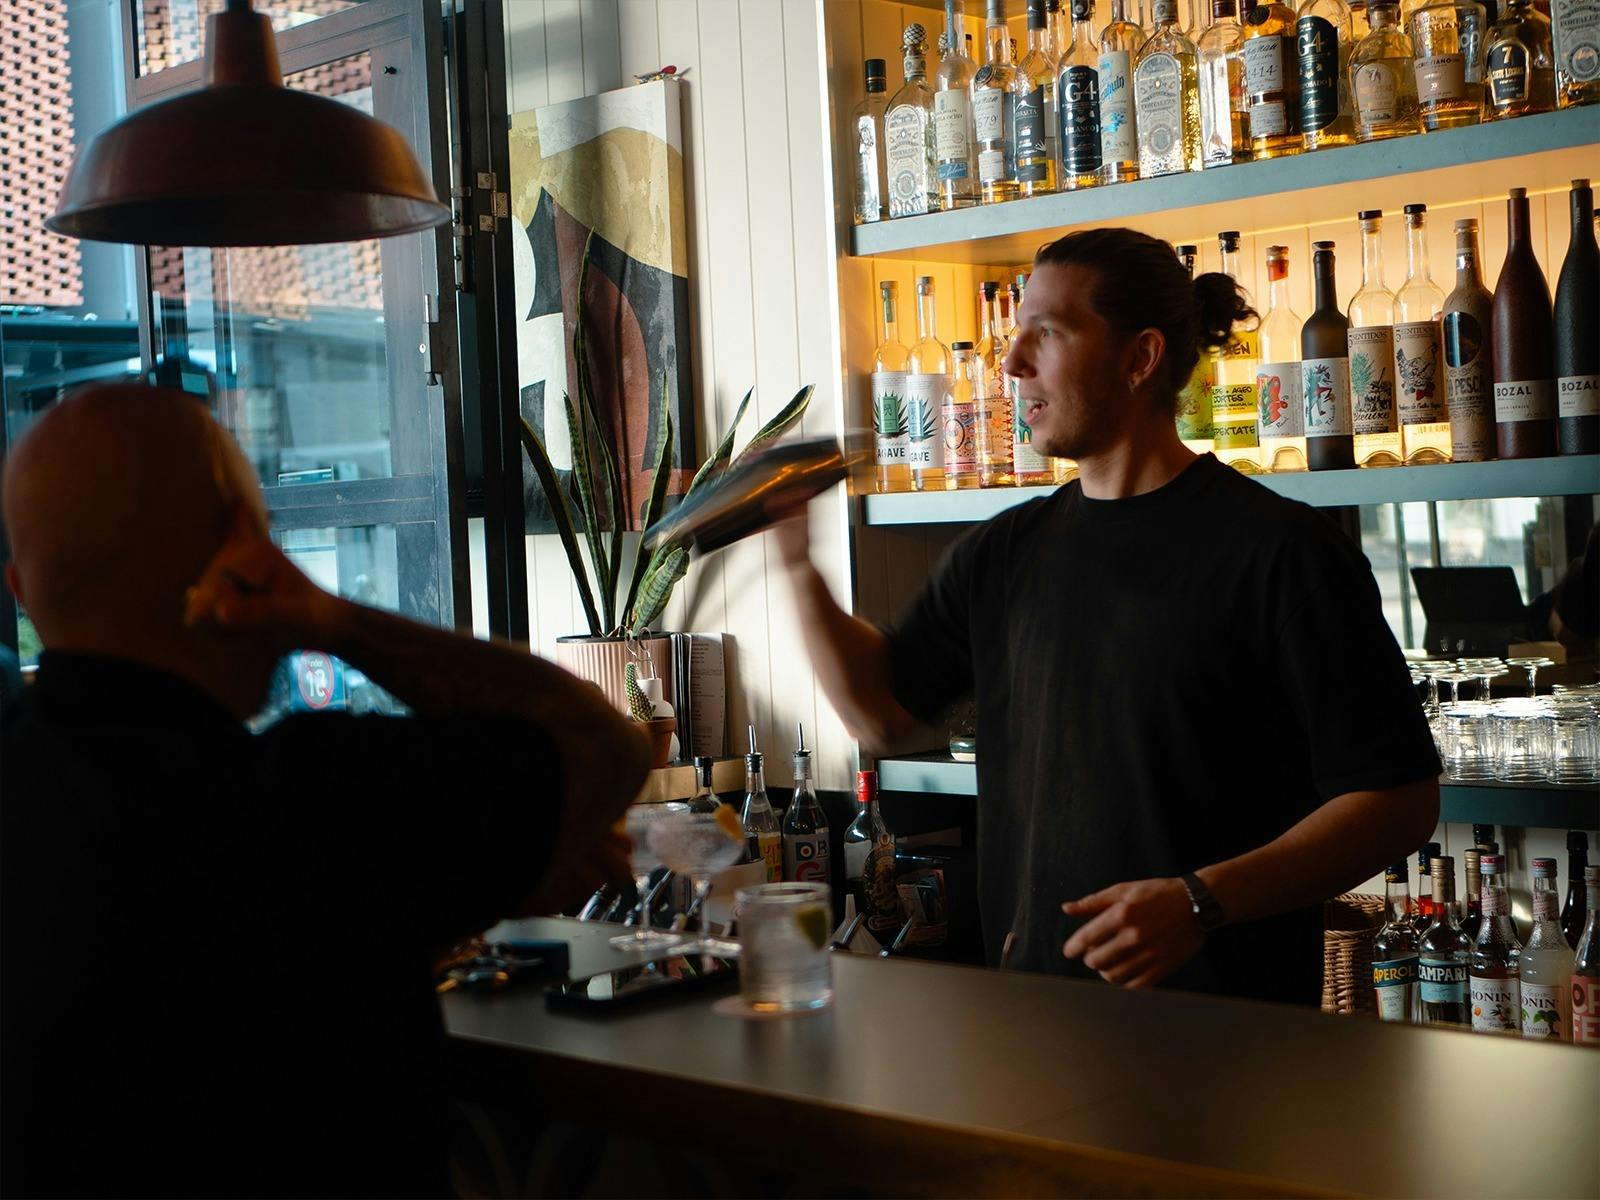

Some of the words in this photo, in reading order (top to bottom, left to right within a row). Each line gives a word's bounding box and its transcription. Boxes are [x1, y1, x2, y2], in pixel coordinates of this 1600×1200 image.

[1560, 14, 1600, 27] FORTALEZ
[1297, 31, 1325, 57] G4
[1065, 80, 1098, 103] G4
[1496, 385, 1532, 397] BOZAL
[1561, 379, 1599, 392] BOZAL
[1213, 425, 1256, 437] PEXTATE
[910, 451, 930, 462] GAVE
[1373, 965, 1416, 984] APEROL
[1418, 964, 1467, 982] CAMPARI
[1521, 997, 1556, 1009] ONIN
